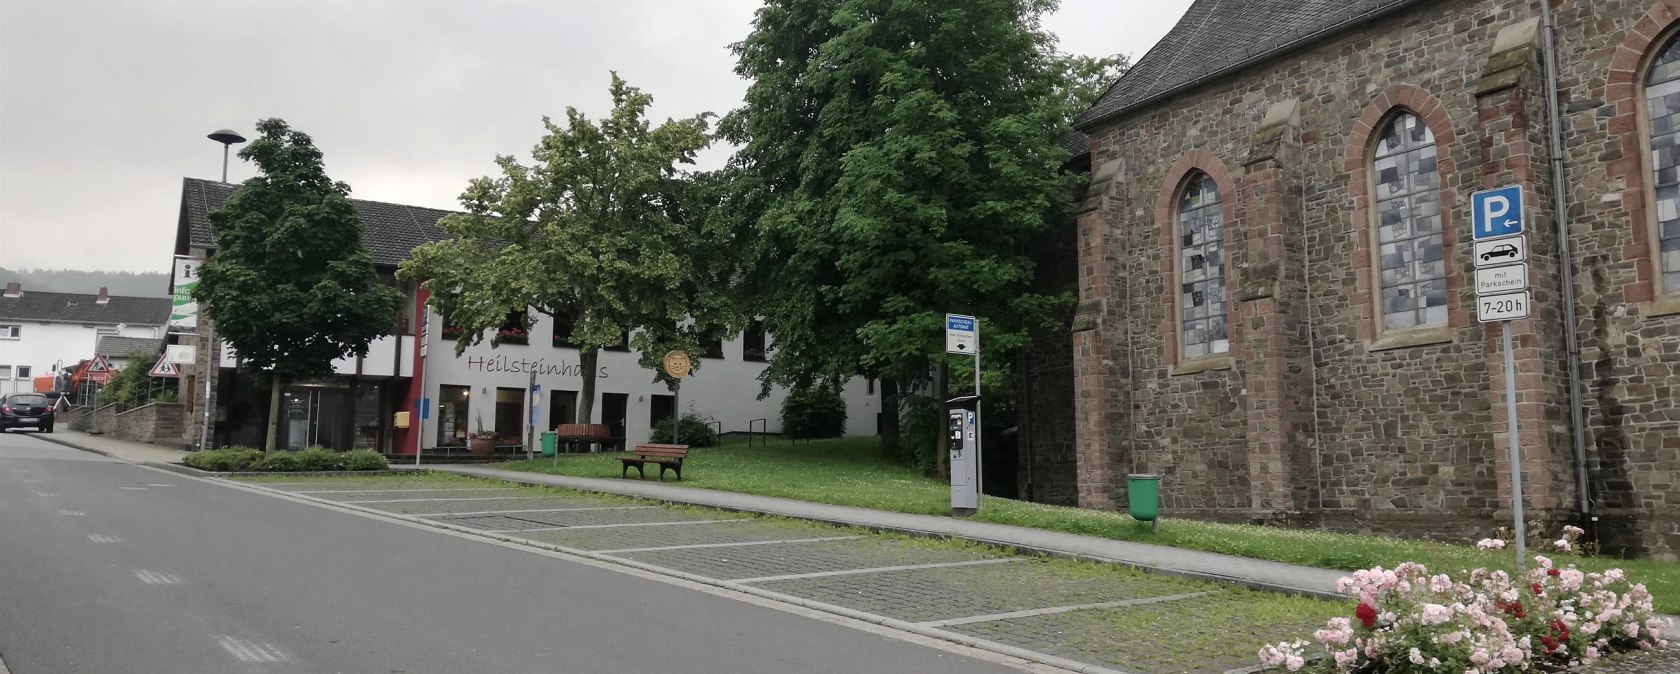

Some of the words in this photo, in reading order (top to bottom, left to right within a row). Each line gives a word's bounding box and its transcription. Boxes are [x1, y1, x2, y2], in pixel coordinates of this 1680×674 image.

[1484, 195, 1510, 232] P
[1494, 271, 1507, 279] mit
[1480, 279, 1522, 288] Parkschein
[1483, 300, 1513, 314] 7-20
[1515, 299, 1522, 311] h
[468, 354, 609, 378] Heilsteinhas
